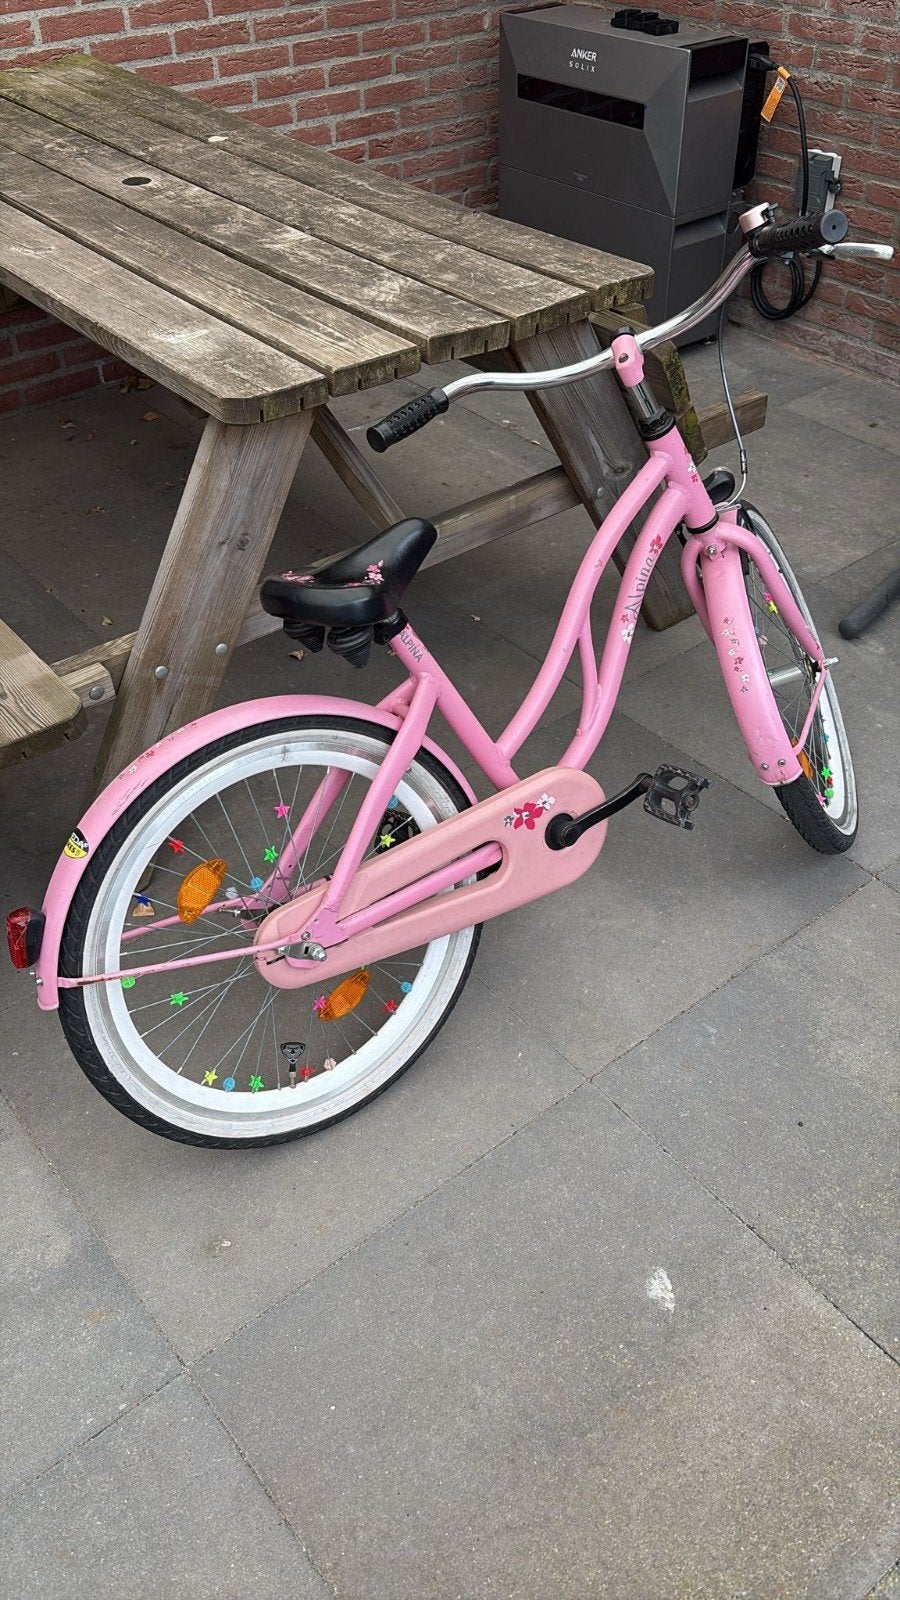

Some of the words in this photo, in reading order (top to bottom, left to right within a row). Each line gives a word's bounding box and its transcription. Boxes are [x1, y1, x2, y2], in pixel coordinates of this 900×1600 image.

[569, 60, 595, 73] SOLIX
[570, 48, 597, 62] ANKER
[624, 557, 655, 620] Alpina
[399, 630, 423, 663] ALPINA
